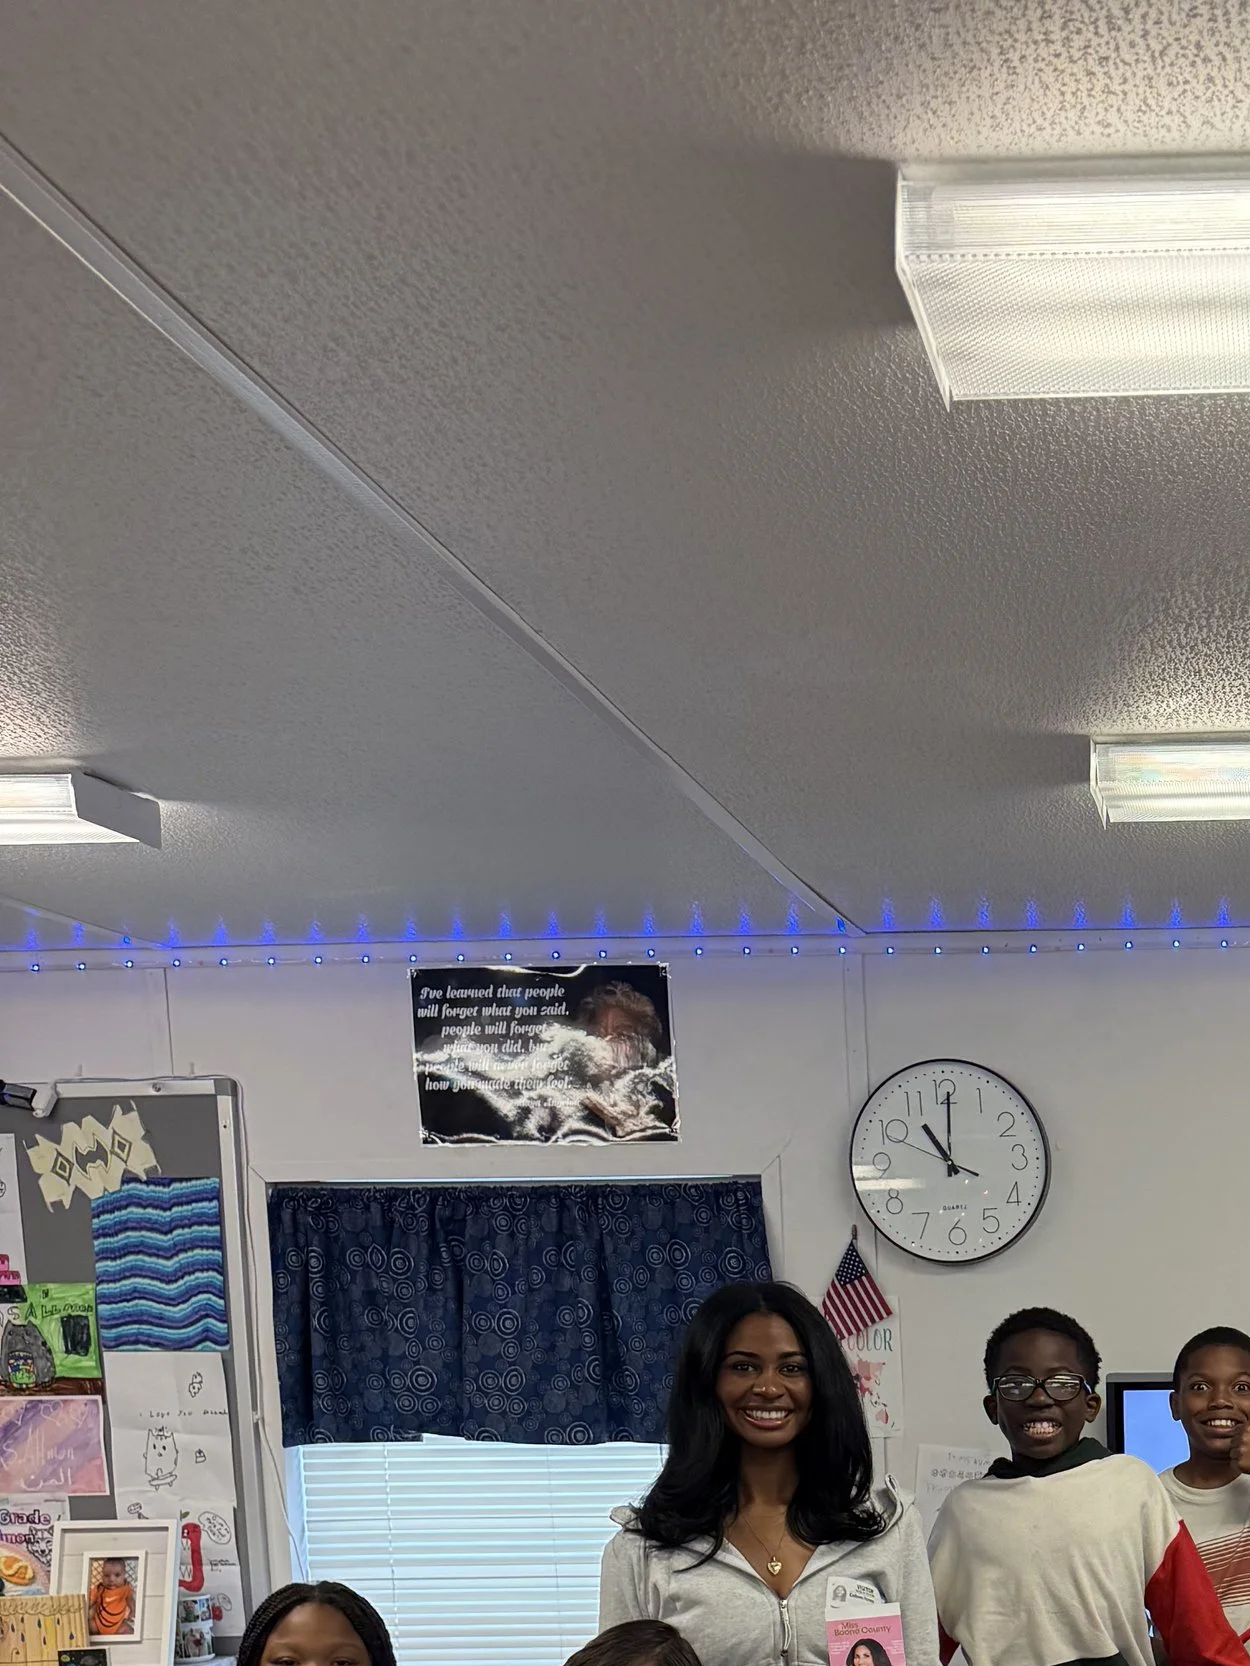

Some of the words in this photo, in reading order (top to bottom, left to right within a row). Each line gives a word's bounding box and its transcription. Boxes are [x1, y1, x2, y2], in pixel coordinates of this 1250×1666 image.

[420, 987, 443, 999] I've
[446, 984, 493, 998] learned
[497, 984, 522, 998] that
[525, 984, 565, 1000] people
[417, 1004, 438, 1018] will
[441, 1004, 477, 1019] forget
[482, 1003, 512, 1016] what
[515, 1006, 537, 1018] you
[441, 1022, 481, 1038] people
[485, 1021, 507, 1034] will
[510, 1020, 547, 1036] forget
[480, 1043, 498, 1055] you
[468, 1059, 490, 1072] will
[425, 1077, 450, 1091] how
[932, 1079, 958, 1105] 12
[904, 1091, 923, 1116] 11
[976, 1088, 983, 1114] 1
[879, 1118, 908, 1145] 10
[997, 1111, 1017, 1137] 2
[872, 1152, 891, 1179] 9
[1011, 1143, 1028, 1170] 3
[886, 1188, 904, 1215] 8
[1006, 1181, 1022, 1206] 4
[911, 1212, 930, 1239] 7
[948, 1219, 967, 1246] 6
[982, 1207, 1000, 1233] 5
[0, 1508, 51, 1526] Grade
[861, 1625, 891, 1635] County
